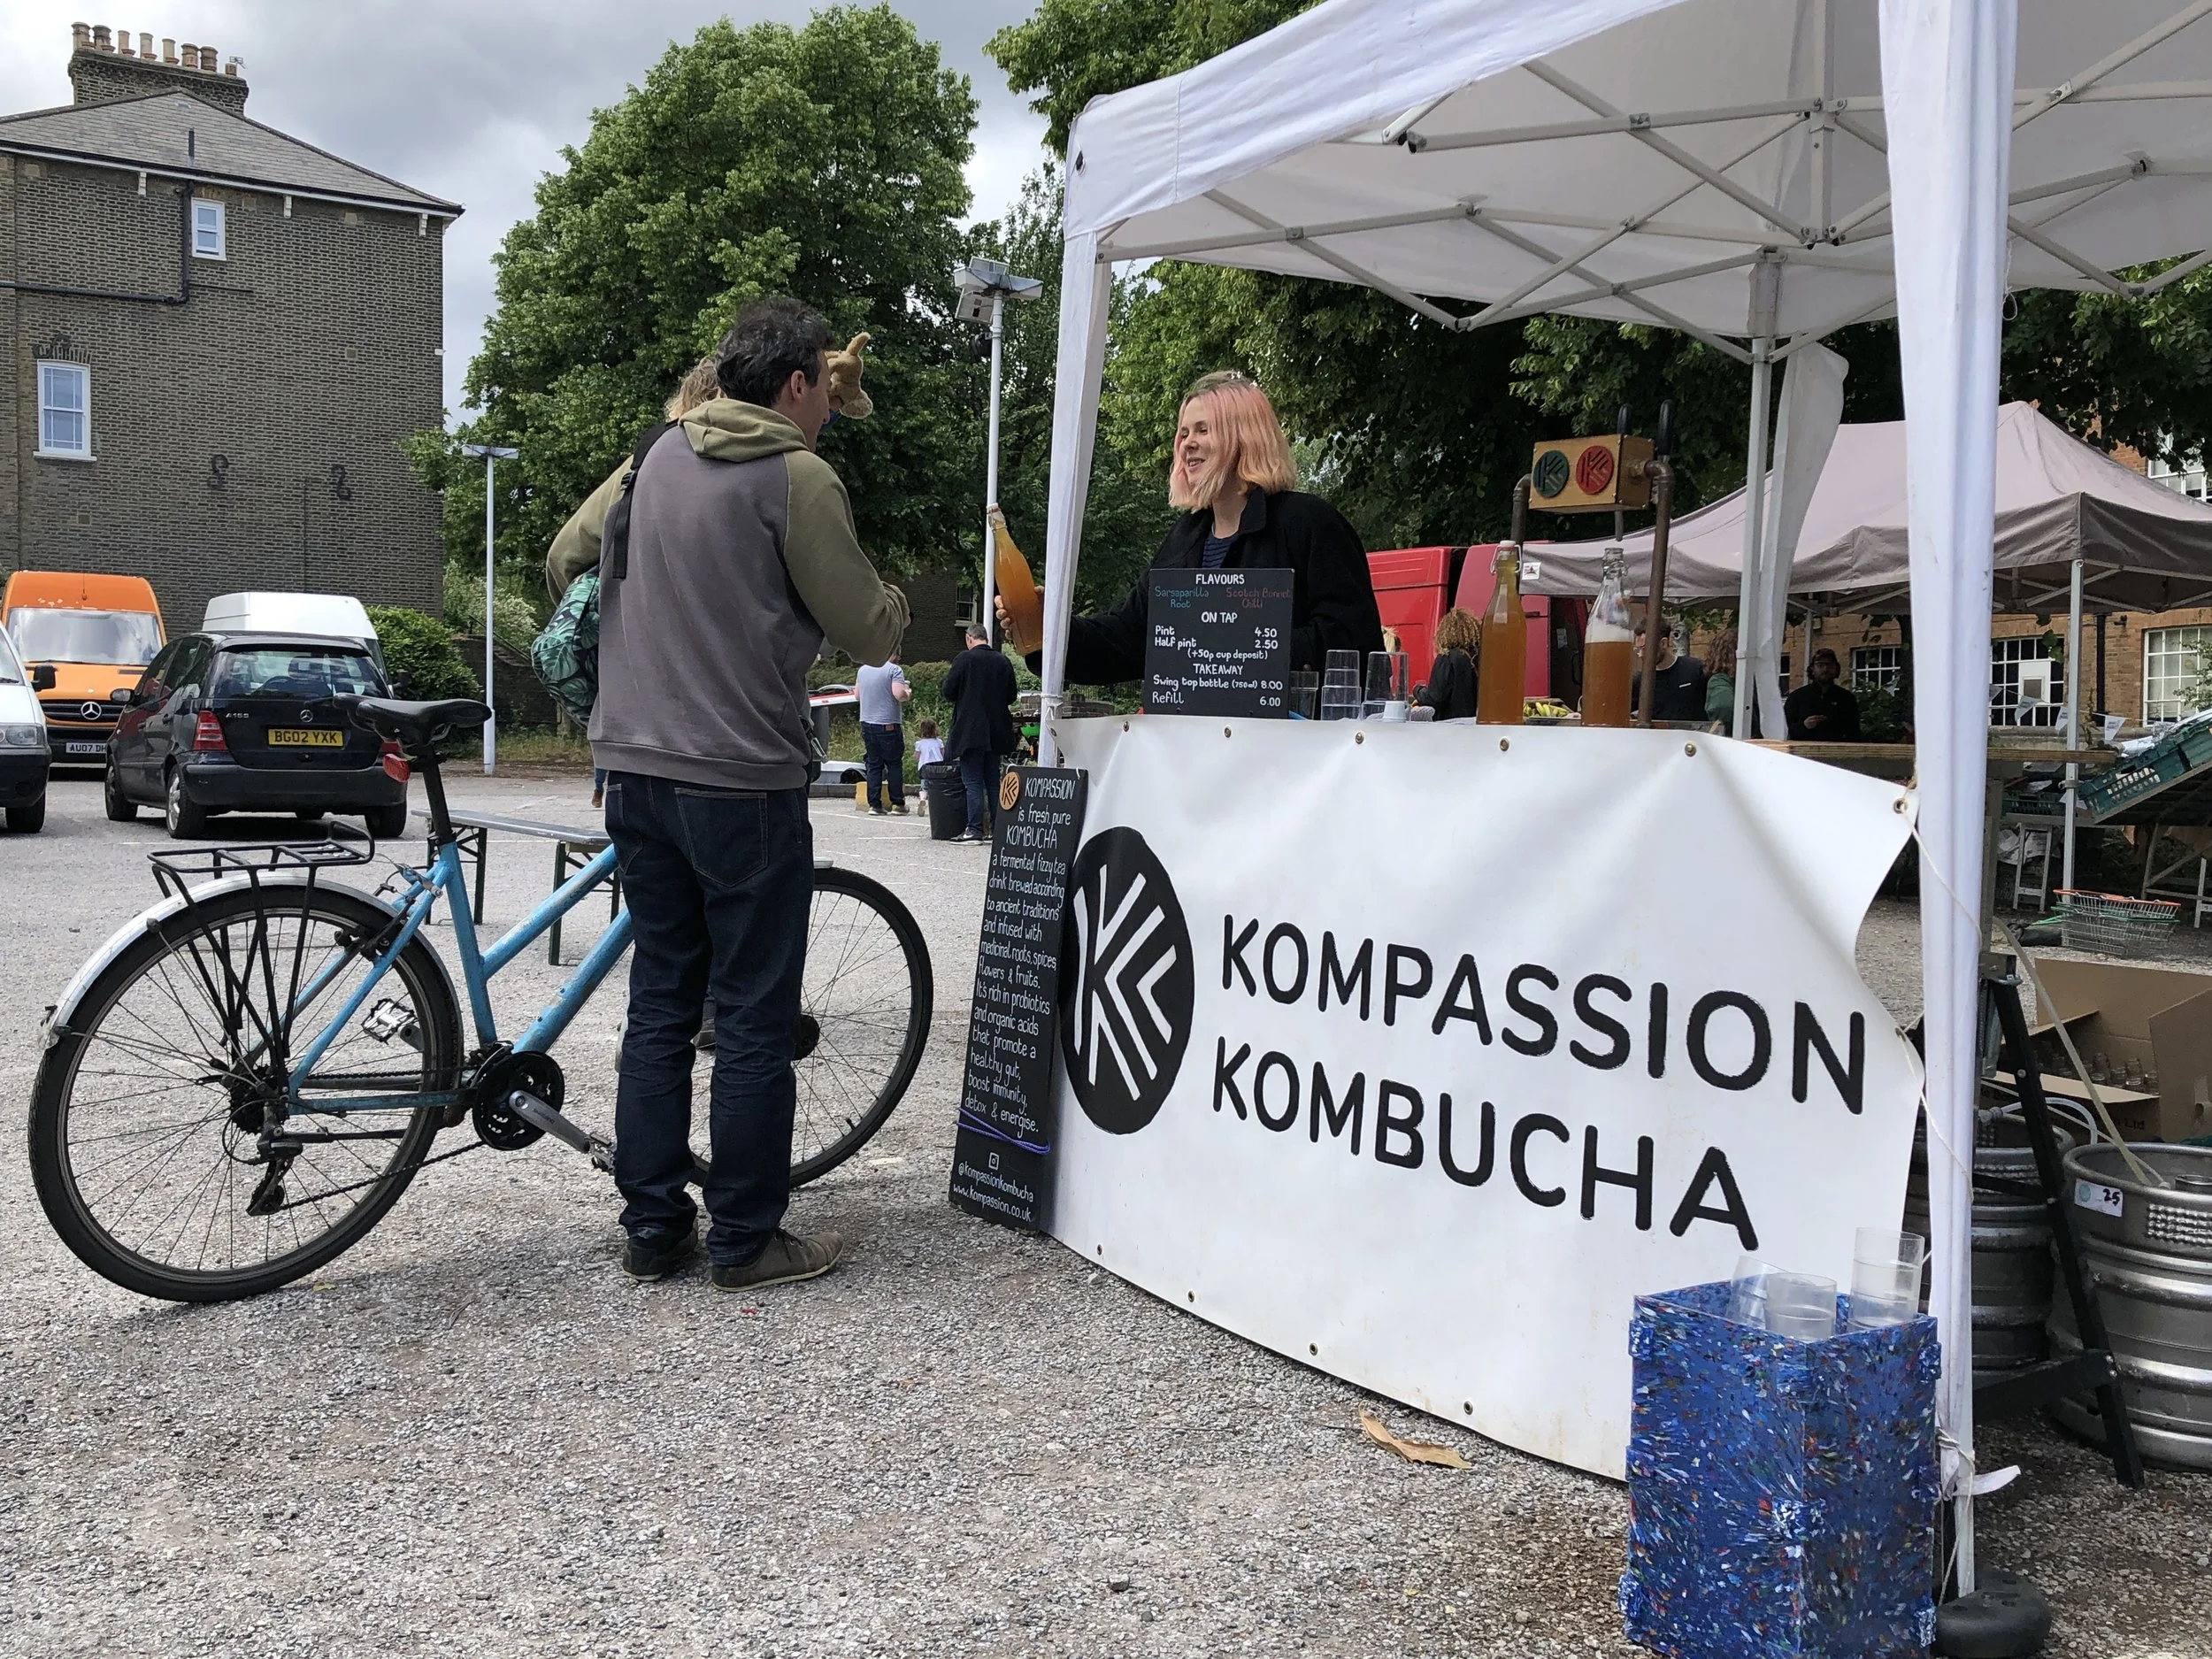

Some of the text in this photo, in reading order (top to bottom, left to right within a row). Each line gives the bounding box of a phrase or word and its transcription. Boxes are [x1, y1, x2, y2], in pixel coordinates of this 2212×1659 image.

[1195, 573, 1245, 585] FLAVOURS
[1155, 586, 1210, 602] Sarsaparilla
[1170, 599, 1191, 609] Root
[1225, 588, 1260, 598] Scotch
[1241, 598, 1263, 609] Chilli
[1201, 611, 1238, 624] ON TAP
[1155, 625, 1278, 638] Pint 4.50
[1155, 637, 1279, 650] Half pint 2.50
[1187, 648, 1268, 663] (+50p cup deposit)
[1193, 664, 1244, 675] TAKEAWAY
[1153, 674, 1179, 692] Swing
[1181, 677, 1198, 691] top
[1199, 678, 1229, 688] bottle
[1261, 680, 1283, 691] 8.00
[1152, 691, 1281, 707] Refill 6.00
[274, 731, 338, 744] BG02 YXK
[1025, 777, 1076, 800] KOMPASSION
[1018, 806, 1025, 822] is
[1050, 812, 1071, 831] pure
[1006, 825, 1057, 849] KOMBUCHA
[992, 847, 1065, 883] a fermented fizzy tea
[989, 870, 1064, 909] drink brewed according
[987, 895, 1060, 921] to ancient traditions
[983, 914, 1042, 941] and infused with
[980, 938, 1011, 958] medicinal
[979, 956, 1041, 988] flowers & fruits.
[976, 978, 1050, 1015] It's rich in probiotics
[974, 1002, 1039, 1036] and organic acids
[1223, 914, 1865, 1115] KOMPASSION
[972, 1024, 1036, 1058] that promote a
[970, 1046, 1021, 1087] healthy gut,
[968, 1068, 990, 1092] boost
[964, 1090, 1039, 1139] detox & energise.
[1214, 1036, 1758, 1251] KOMBUCHA
[958, 1160, 1033, 1202] @kompassionkombucha
[953, 1183, 1032, 1222] www.kompassion.co.uk
[2102, 1187, 2120, 1207] 25
